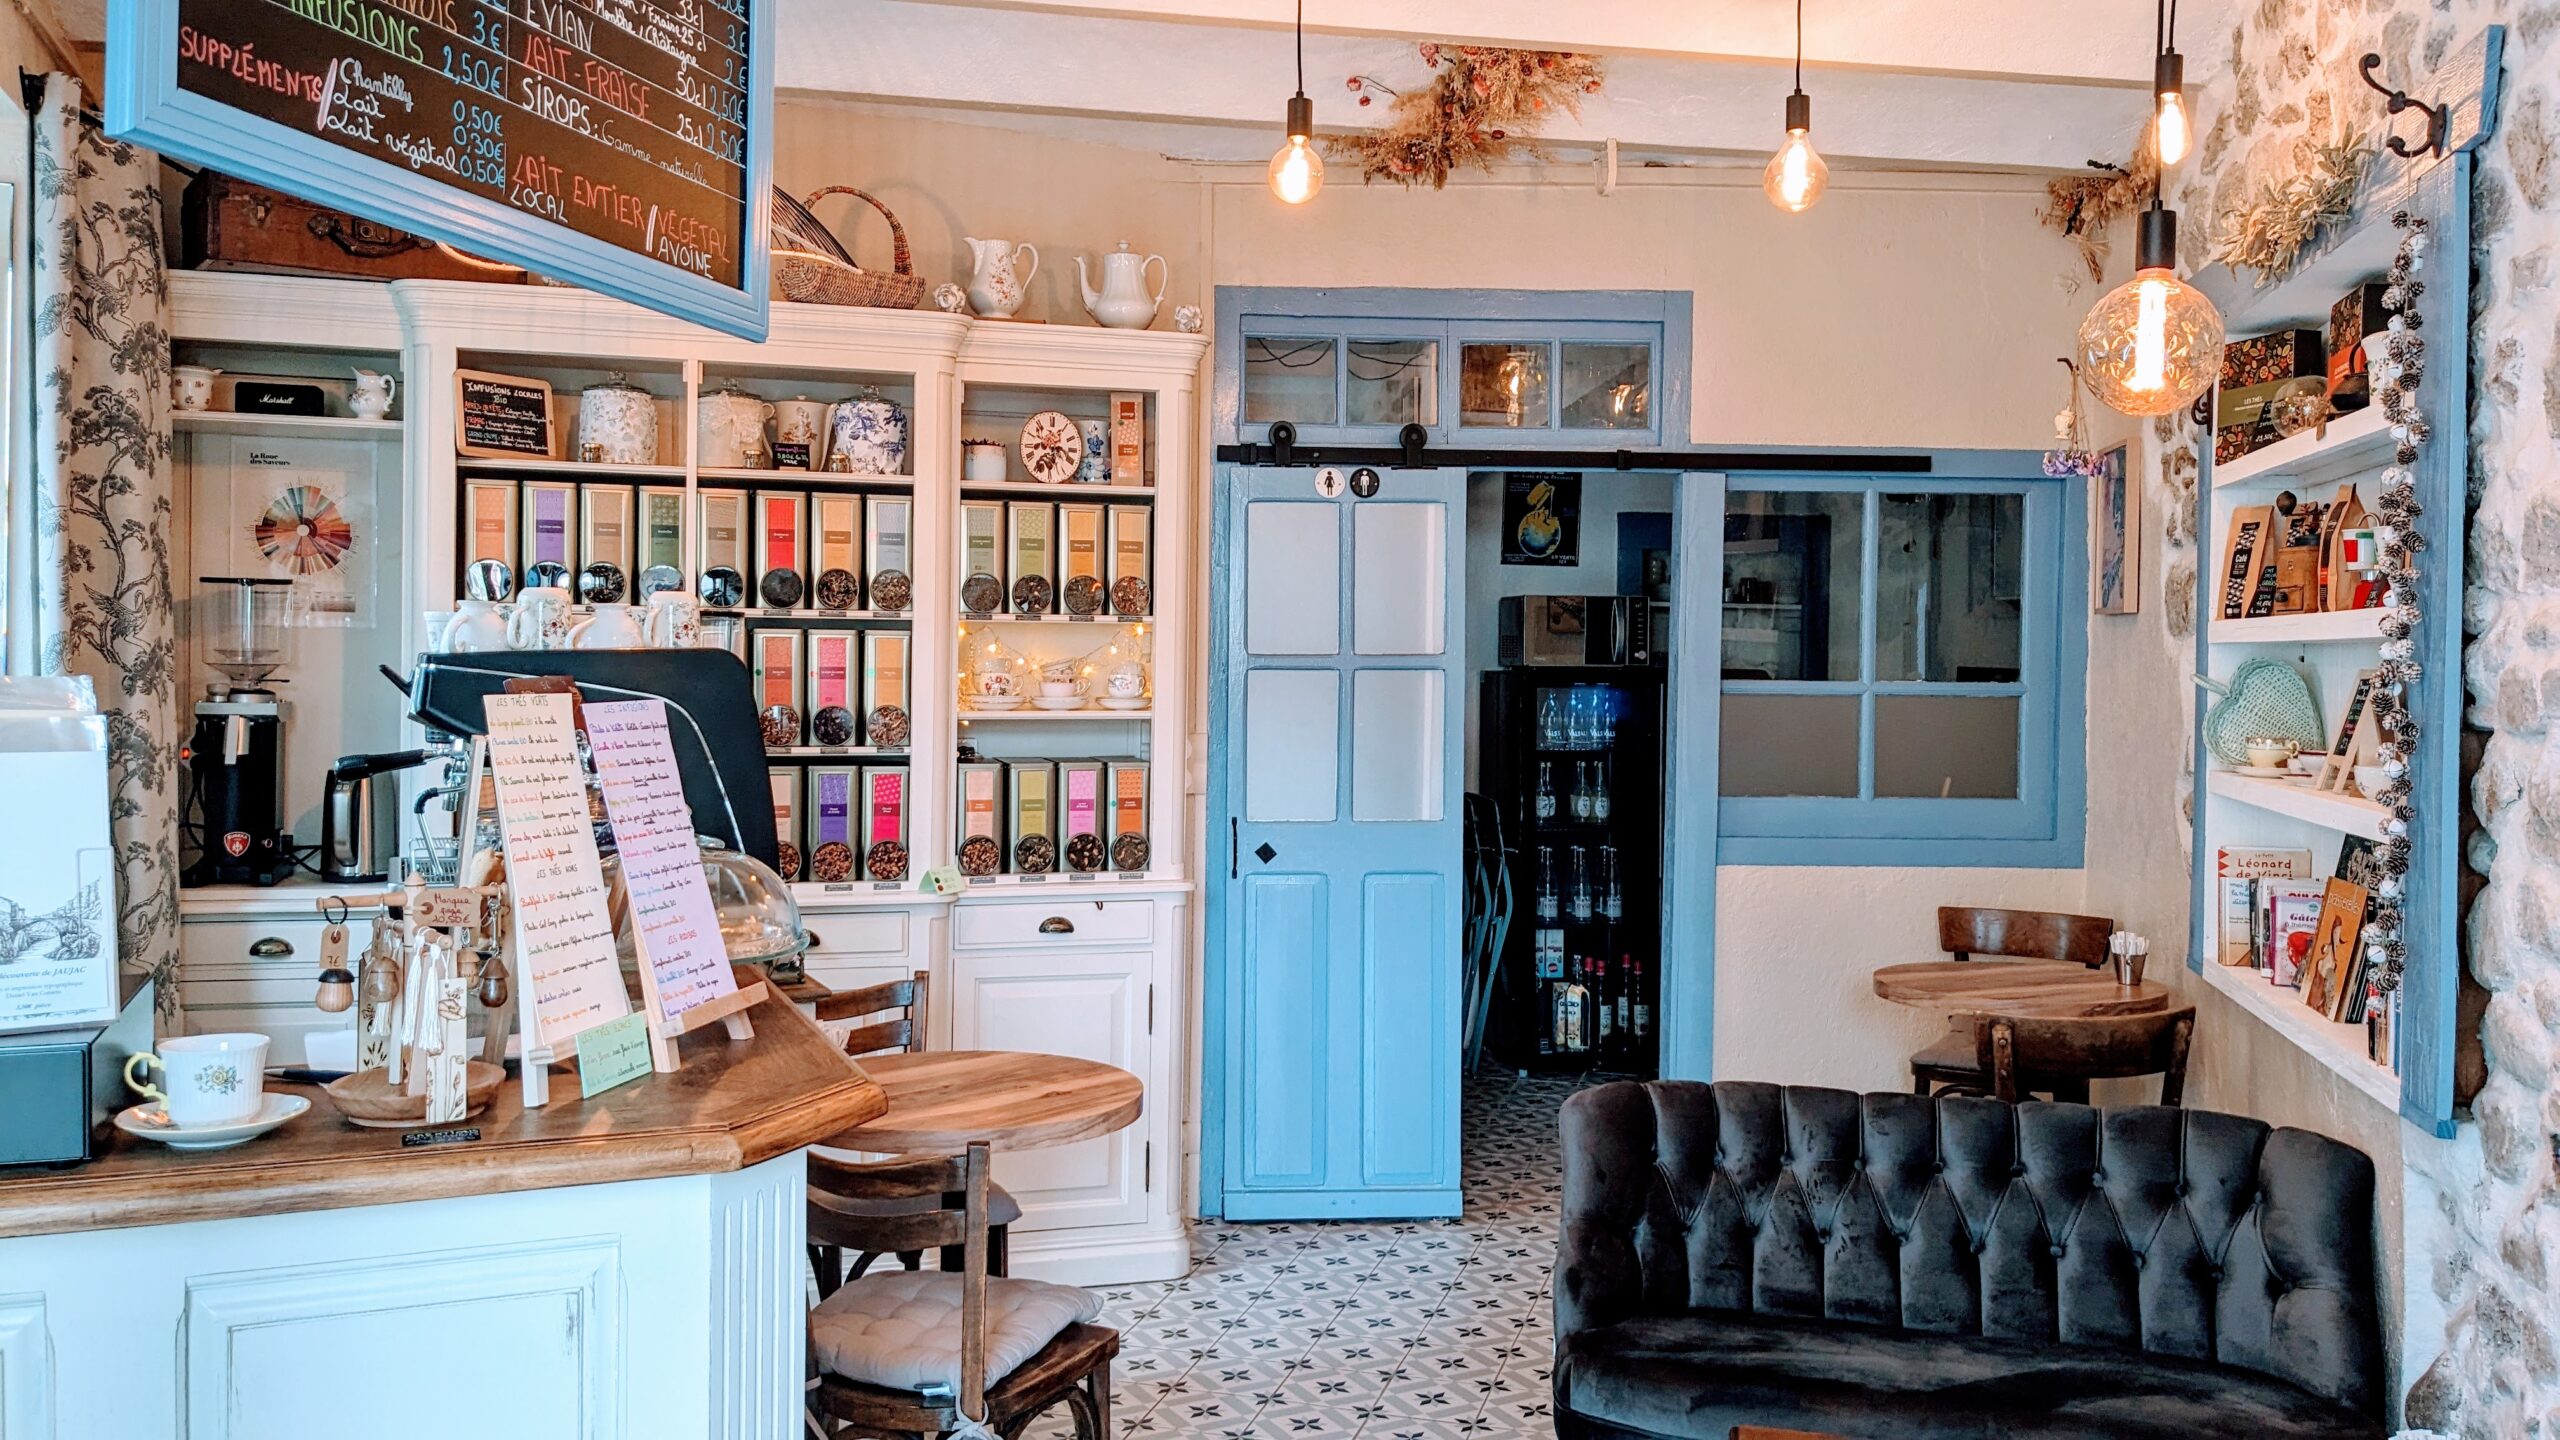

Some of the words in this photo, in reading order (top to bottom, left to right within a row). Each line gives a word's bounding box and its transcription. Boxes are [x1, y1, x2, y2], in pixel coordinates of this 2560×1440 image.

[180, 26, 324, 103] SUPPLÉMENTS
[443, 45, 505, 97] 2,50€
[526, 0, 594, 53] EVIAN
[710, 85, 746, 122] 2,50€
[340, 57, 413, 113] Chantilly
[453, 100, 503, 136] 0,50€
[333, 85, 386, 118] Lait
[453, 125, 504, 161] 0,30€
[706, 122, 745, 160] 2,50€
[326, 112, 379, 144] Lait
[386, 132, 460, 173] végétal
[459, 156, 506, 188] 0,50€
[601, 120, 652, 162] Gamme
[660, 156, 709, 188] naturelle
[512, 153, 563, 196] LAIT
[573, 175, 645, 232] ENTIER
[656, 209, 731, 264] VÉGÉTAL
[510, 183, 568, 224] LOCAL
[657, 236, 714, 280] AVOINE
[259, 393, 295, 404] Marshall
[465, 381, 511, 397] INFUSIONS
[513, 389, 543, 400] LOCALES
[2235, 553, 2249, 563] Café
[511, 693, 527, 706] THÉS
[530, 694, 549, 706] VERTS
[2236, 870, 2251, 879] de
[2237, 858, 2292, 869] Léonard
[434, 893, 472, 908] Marque
[53, 966, 87, 977] JAUJAC
